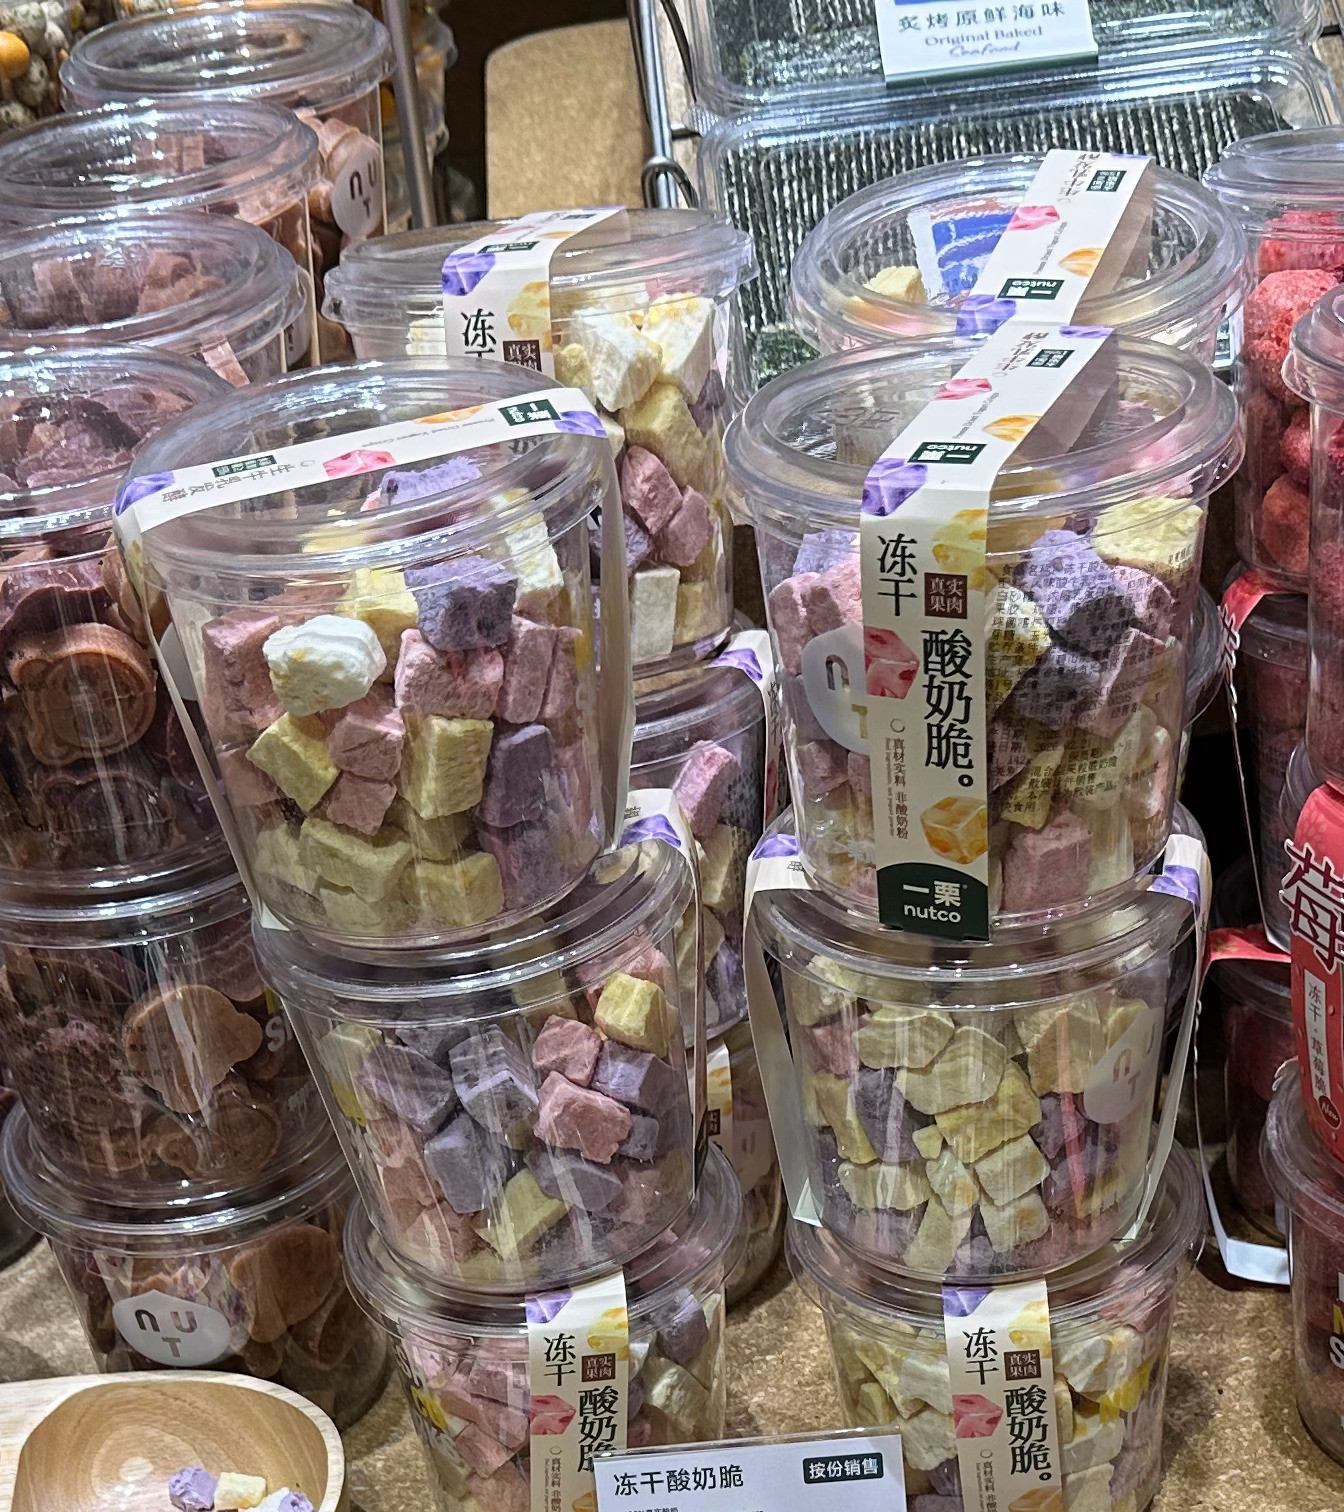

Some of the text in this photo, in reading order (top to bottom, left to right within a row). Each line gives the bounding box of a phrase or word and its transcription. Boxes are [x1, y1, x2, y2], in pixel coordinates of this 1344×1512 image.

[899, 2, 1065, 33] 炙烤原鲜海味
[924, 32, 990, 48] Original
[877, 533, 918, 617] 冻干
[902, 881, 962, 908] 一栗
[903, 902, 962, 924] nutco
[543, 1332, 577, 1387] 冻干
[963, 1327, 999, 1385] 冻干
[613, 1456, 880, 1497] 冻干酸奶脆 按份销售
